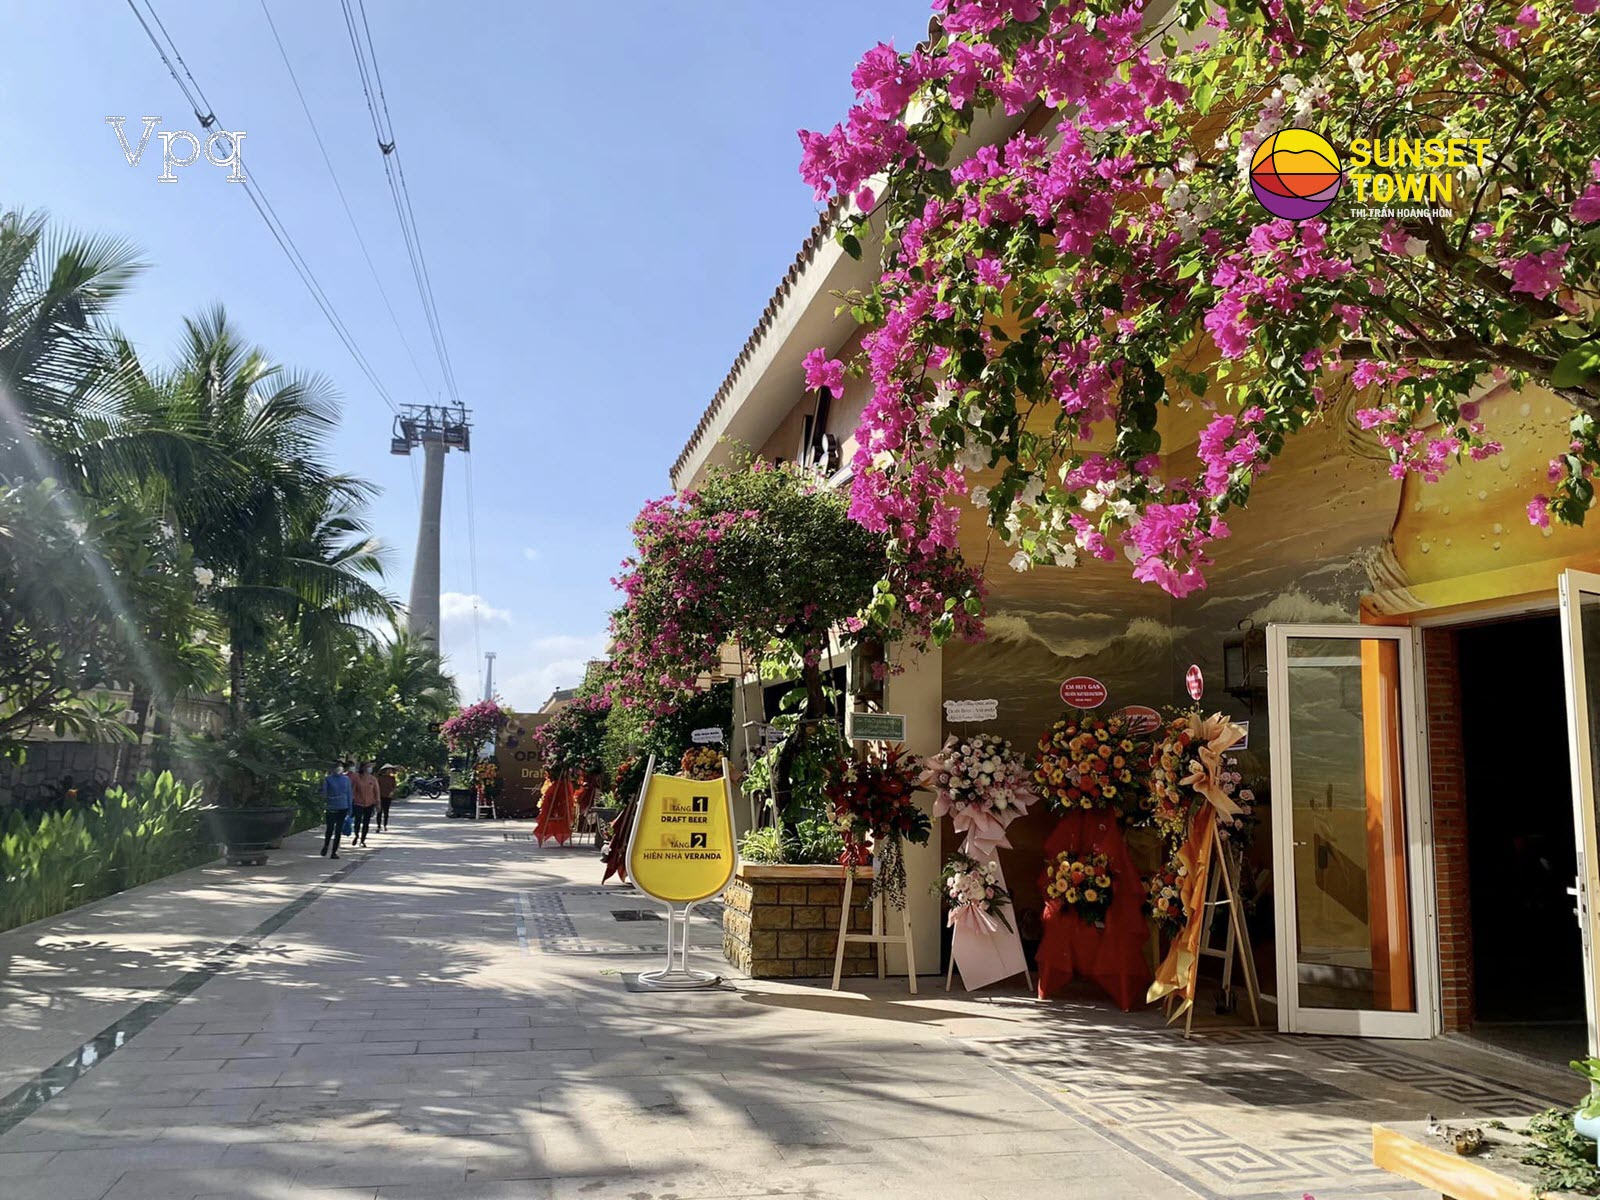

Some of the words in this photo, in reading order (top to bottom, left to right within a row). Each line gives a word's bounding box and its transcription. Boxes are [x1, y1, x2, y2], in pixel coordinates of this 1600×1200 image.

[521, 768, 544, 778] Draf
[695, 798, 705, 812] 1
[693, 834, 704, 848] 2
[684, 852, 722, 860] VERANDA
